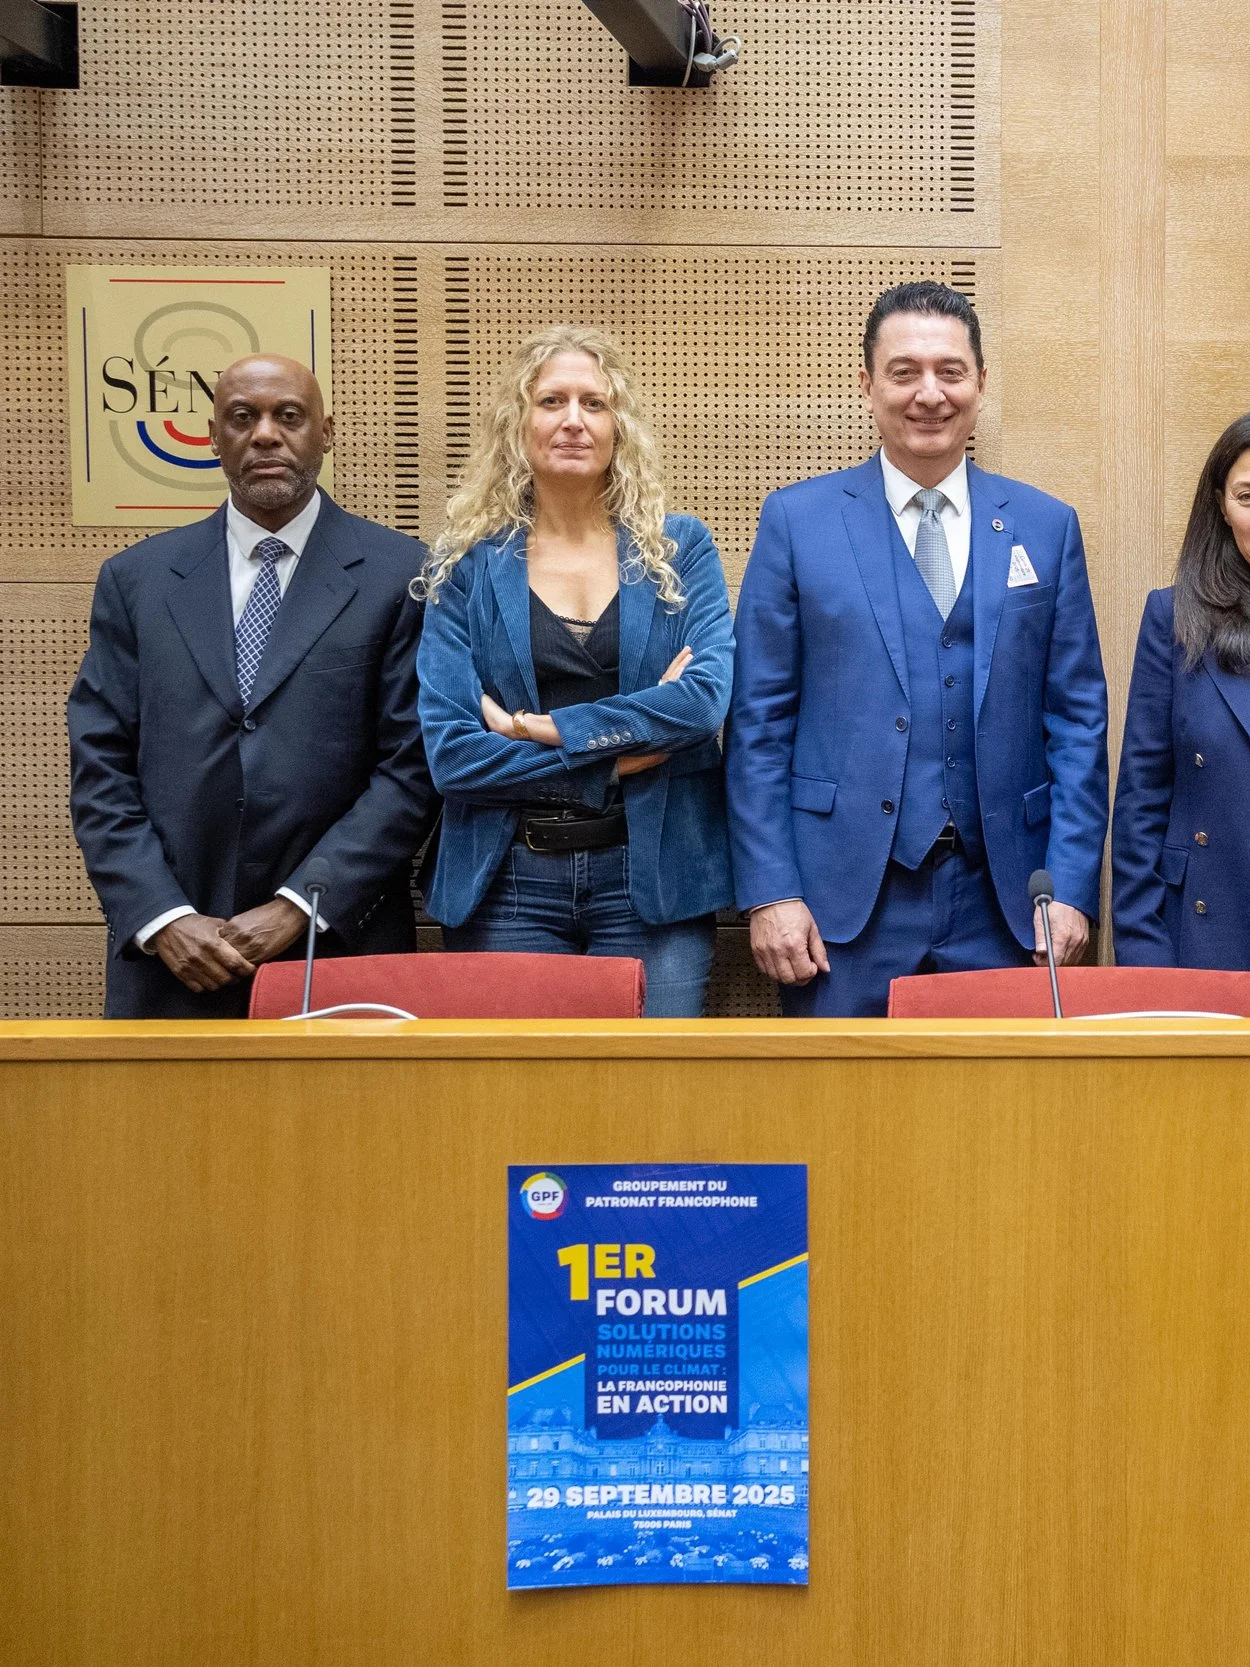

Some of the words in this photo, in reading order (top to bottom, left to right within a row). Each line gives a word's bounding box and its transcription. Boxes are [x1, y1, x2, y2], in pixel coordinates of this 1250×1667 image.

[102, 355, 224, 413] SÉN
[613, 1180, 706, 1192] GROUPEMENT
[707, 1180, 727, 1191] DU
[531, 1191, 560, 1202] GPF
[585, 1196, 656, 1208] PATRONAT
[658, 1196, 758, 1207] FRANCOPHONE
[596, 1288, 727, 1316] FORUM
[598, 1323, 726, 1340] SOLUTIONS
[597, 1340, 726, 1360] NUMÉRIQUES
[598, 1364, 639, 1376] POUR
[643, 1364, 660, 1375] LE
[664, 1364, 720, 1375] CLIMAT
[597, 1381, 616, 1393] LA
[618, 1380, 727, 1392] FRANCOPHONIE
[597, 1395, 630, 1414] EN
[635, 1394, 727, 1413] ACTION
[526, 1486, 560, 1509] 29
[565, 1484, 727, 1507] SEPTEMBRE
[732, 1484, 796, 1505] 2025
[586, 1510, 621, 1519] PALAIS
[623, 1510, 636, 1518] DU
[638, 1509, 706, 1518] LUXEMBOURG,
[707, 1507, 738, 1518] SÉNAT
[663, 1520, 692, 1529] PARIS
